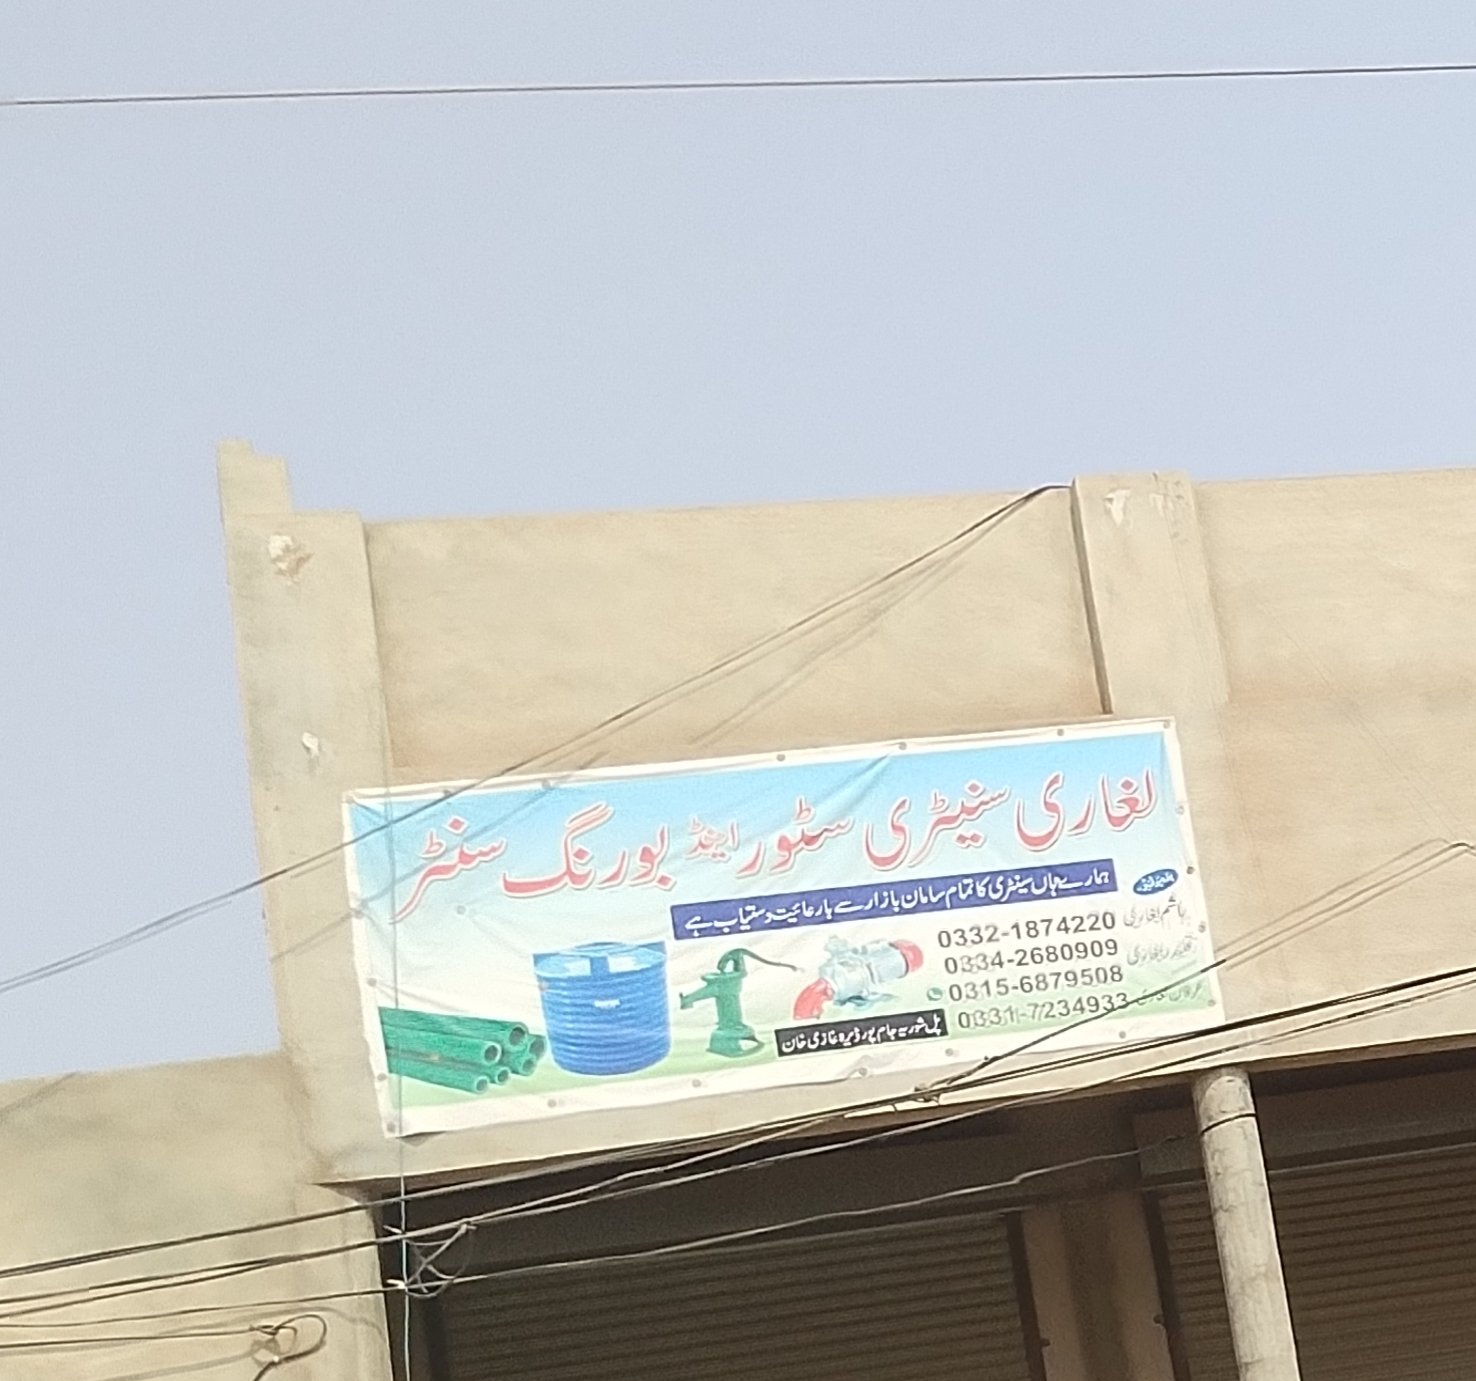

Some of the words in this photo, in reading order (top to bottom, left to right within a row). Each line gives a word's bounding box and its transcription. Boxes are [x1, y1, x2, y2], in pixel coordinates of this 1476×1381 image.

[1014, 768, 1158, 852] لغاری
[684, 816, 741, 861] اینڈ
[736, 796, 854, 877] سٹور
[865, 779, 1010, 870] سنیٹری
[500, 801, 677, 897] بورنگ
[389, 816, 507, 926] سنٹر
[1055, 868, 1110, 890] ہمارے
[864, 890, 900, 912] بازار
[900, 884, 946, 909] سامان
[944, 878, 974, 909] تمام
[976, 876, 991, 898] کا
[684, 914, 713, 937] ہے
[938, 911, 1116, 948] 0332-1874220
[944, 938, 1119, 975] 0334-2680909
[948, 965, 1124, 1002] 0315-6879508
[781, 1032, 808, 1053] خان
[807, 1030, 838, 1050] غازی
[838, 1026, 862, 1046] ڈیرہ
[861, 1027, 877, 1044] پور
[876, 1023, 897, 1042] جام
